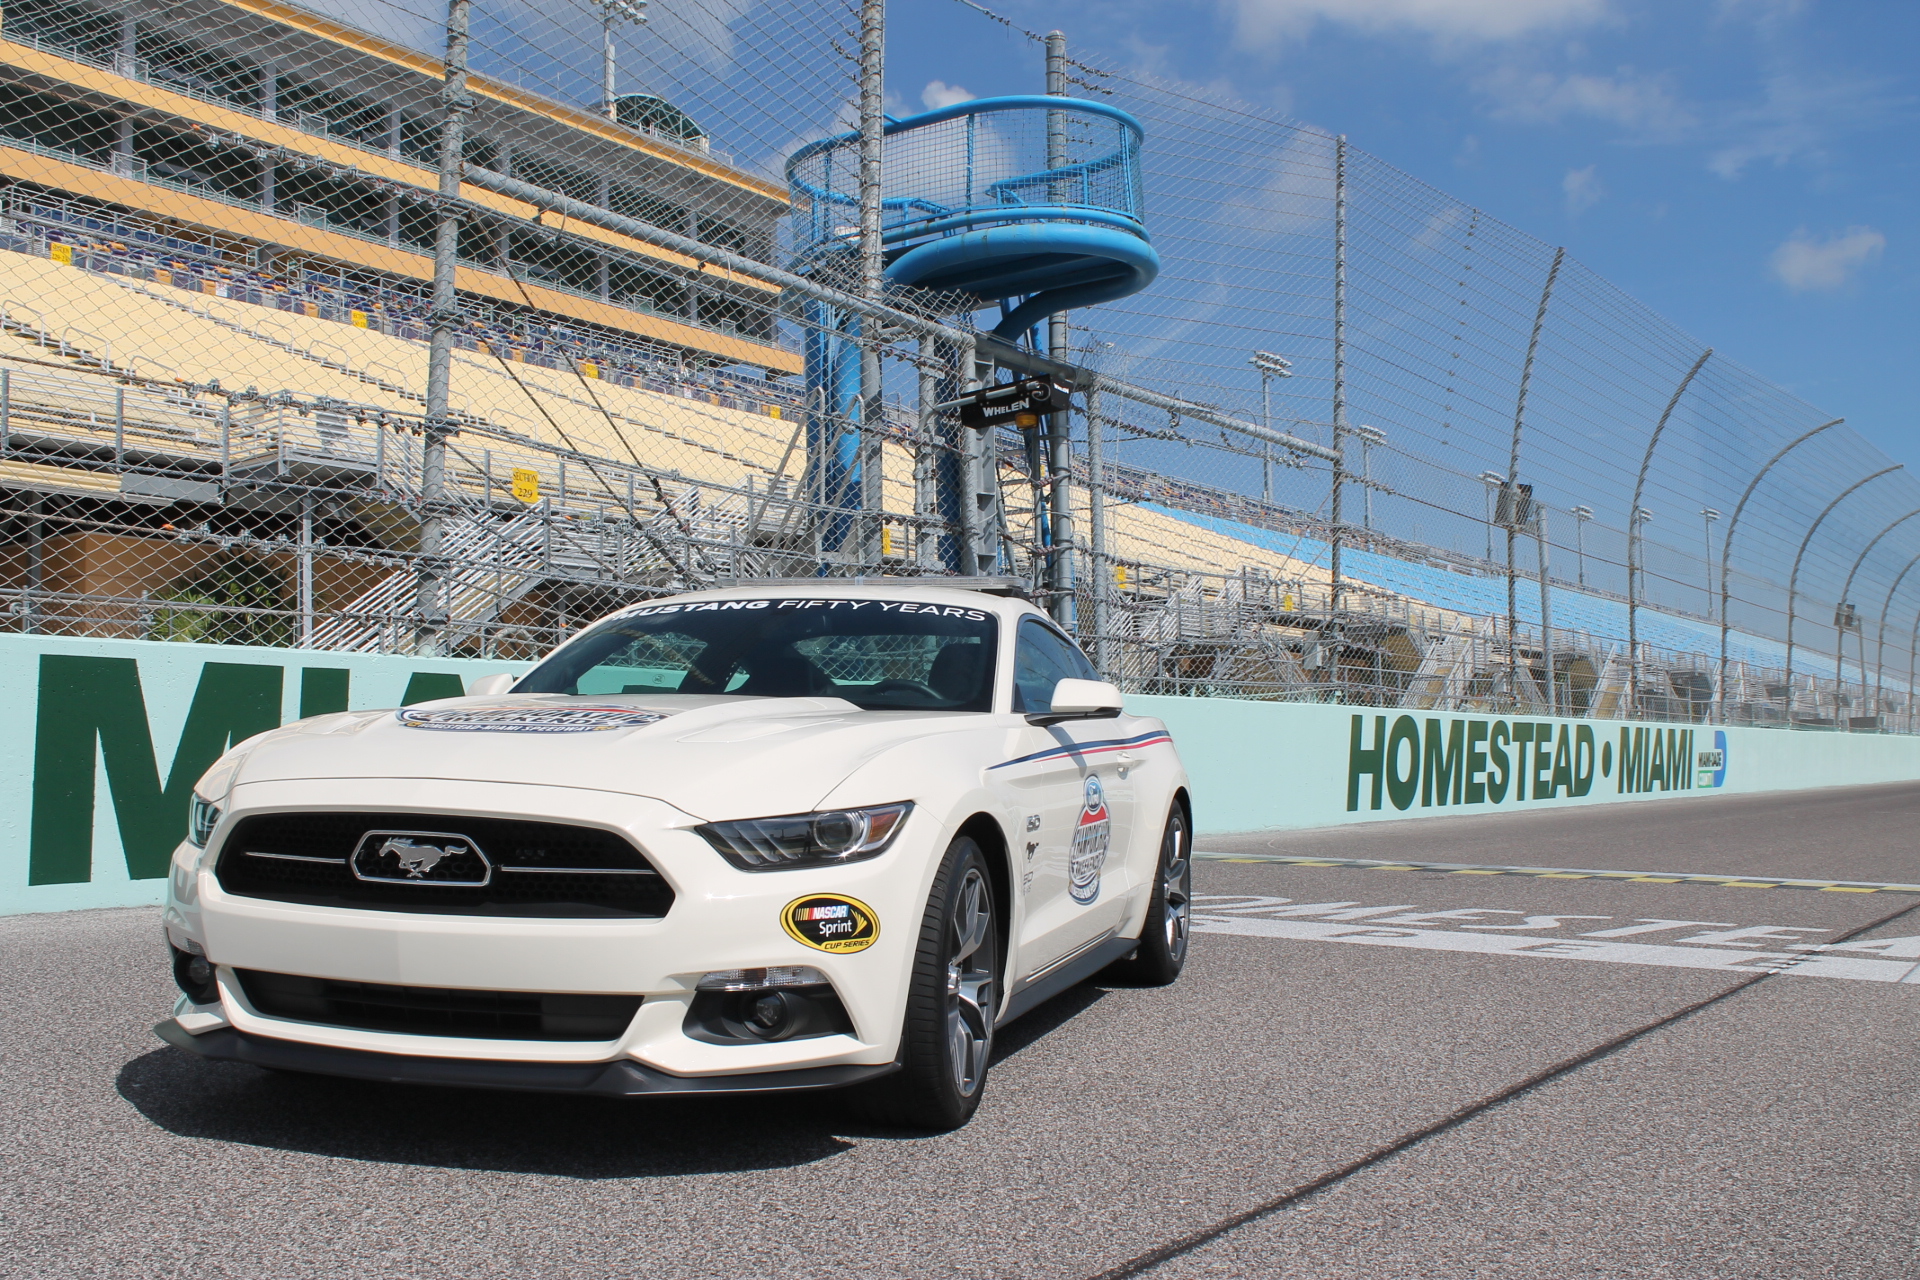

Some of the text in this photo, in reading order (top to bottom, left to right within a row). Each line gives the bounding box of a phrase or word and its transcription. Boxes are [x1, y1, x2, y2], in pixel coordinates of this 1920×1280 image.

[982, 397, 1030, 417] WHELEN
[517, 487, 533, 499] 229
[612, 600, 986, 622] MUSTANG FIFTY YEARS
[1346, 714, 1694, 811] HOMESTEAD MIAMI
[812, 905, 848, 920] NASCAR
[819, 920, 852, 937] Sprint
[843, 940, 870, 948] SERIES
